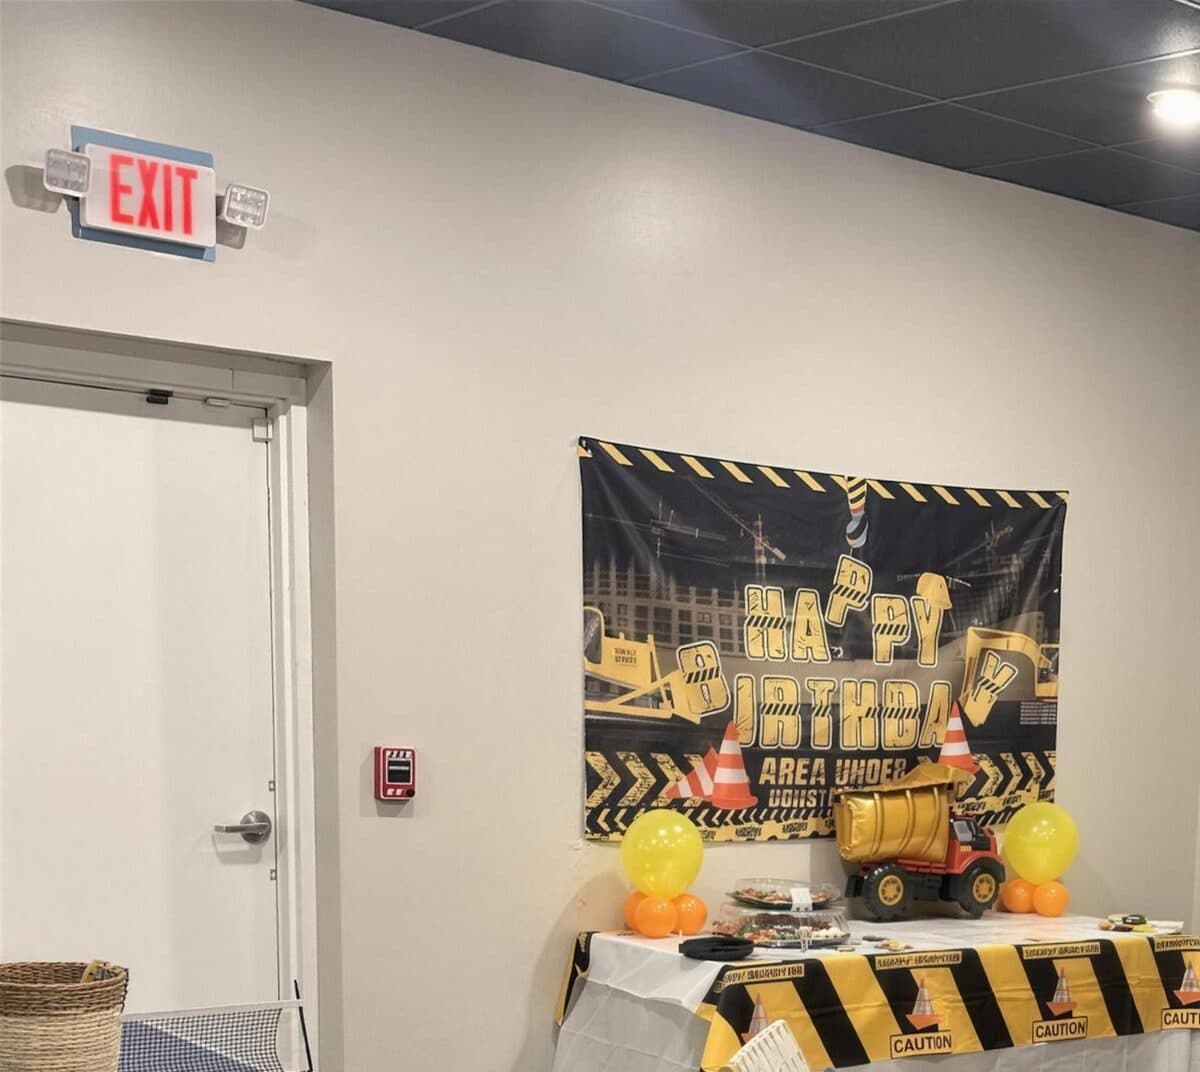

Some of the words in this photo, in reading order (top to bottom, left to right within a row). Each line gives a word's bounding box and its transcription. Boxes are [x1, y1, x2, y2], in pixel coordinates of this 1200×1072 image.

[108, 153, 199, 236] EXIT
[745, 555, 944, 667] HAPPY
[676, 640, 1018, 750] BIRTHDAY
[758, 757, 826, 785] AREA
[893, 1036, 952, 1054] CAUTION
[1035, 1021, 1086, 1038] CAUTION
